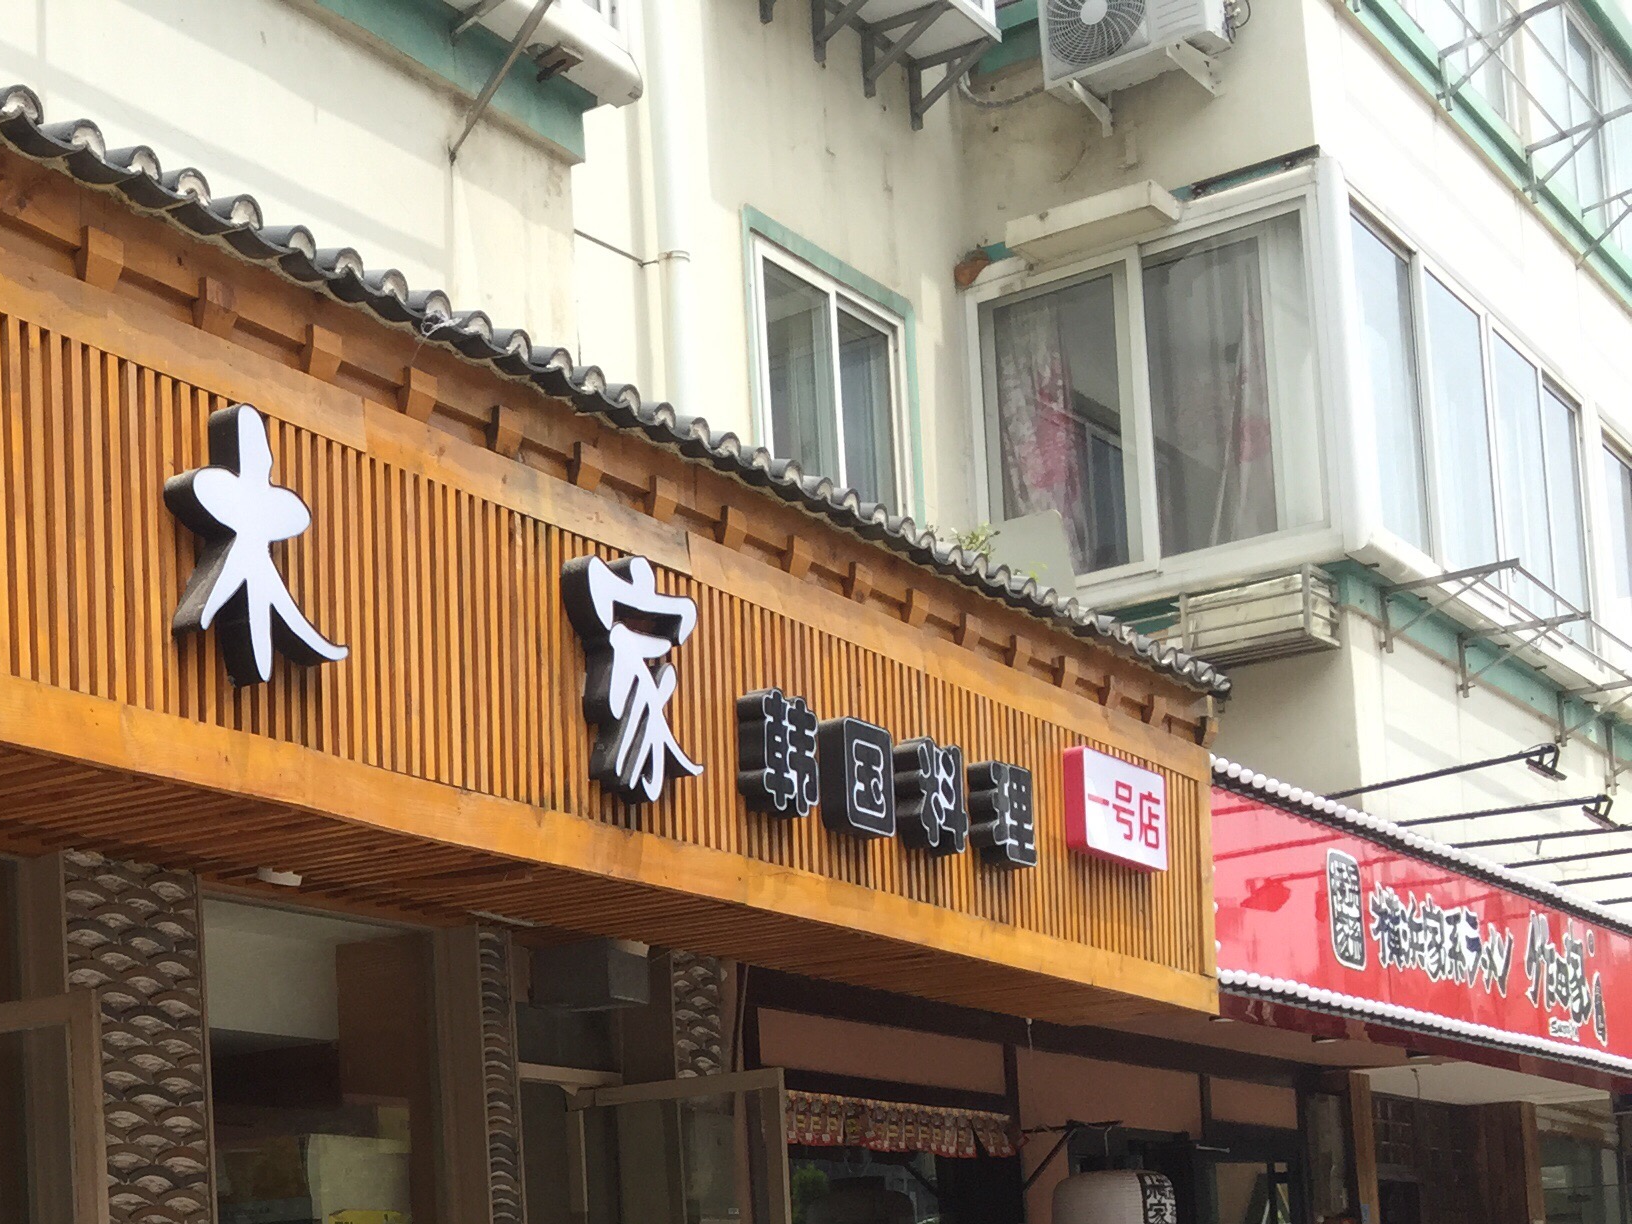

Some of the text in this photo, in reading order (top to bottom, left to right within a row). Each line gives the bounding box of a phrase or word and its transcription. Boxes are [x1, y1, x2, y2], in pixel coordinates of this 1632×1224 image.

[740, 686, 1038, 870] 韩国料理
[1087, 780, 1161, 850] 一号店
